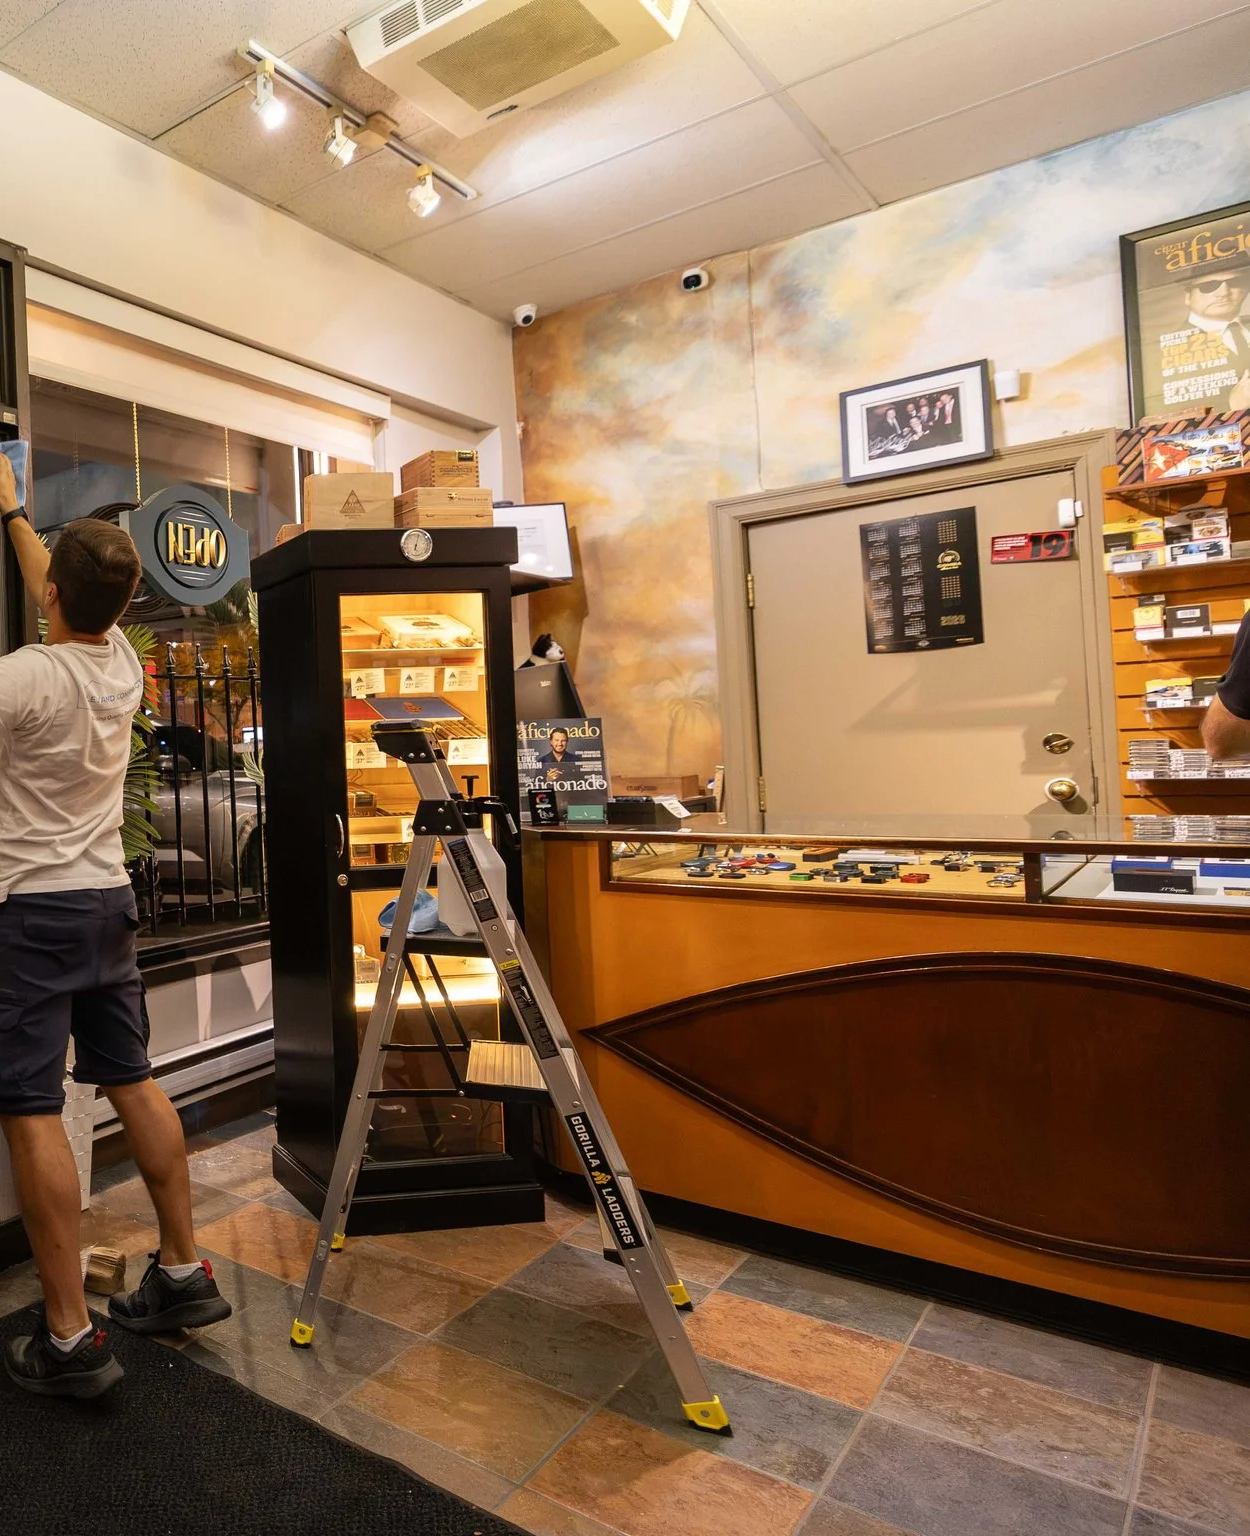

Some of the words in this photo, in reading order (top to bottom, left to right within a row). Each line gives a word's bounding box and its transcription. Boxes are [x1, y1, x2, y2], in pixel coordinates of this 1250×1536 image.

[1154, 241, 1188, 255] cigar
[1162, 345, 1230, 369] CIGARS
[1162, 368, 1175, 377] OF
[1177, 363, 1199, 374] THE
[1201, 357, 1228, 369] YEAR
[1163, 369, 1237, 390] CONFESSIONS
[1178, 386, 1188, 395] A
[1188, 376, 1239, 392] WEEKEND
[167, 521, 226, 568] OPEN
[1030, 533, 1066, 557] 19
[571, 1116, 601, 1167] GORILLA
[602, 1188, 635, 1244] LADDERS
